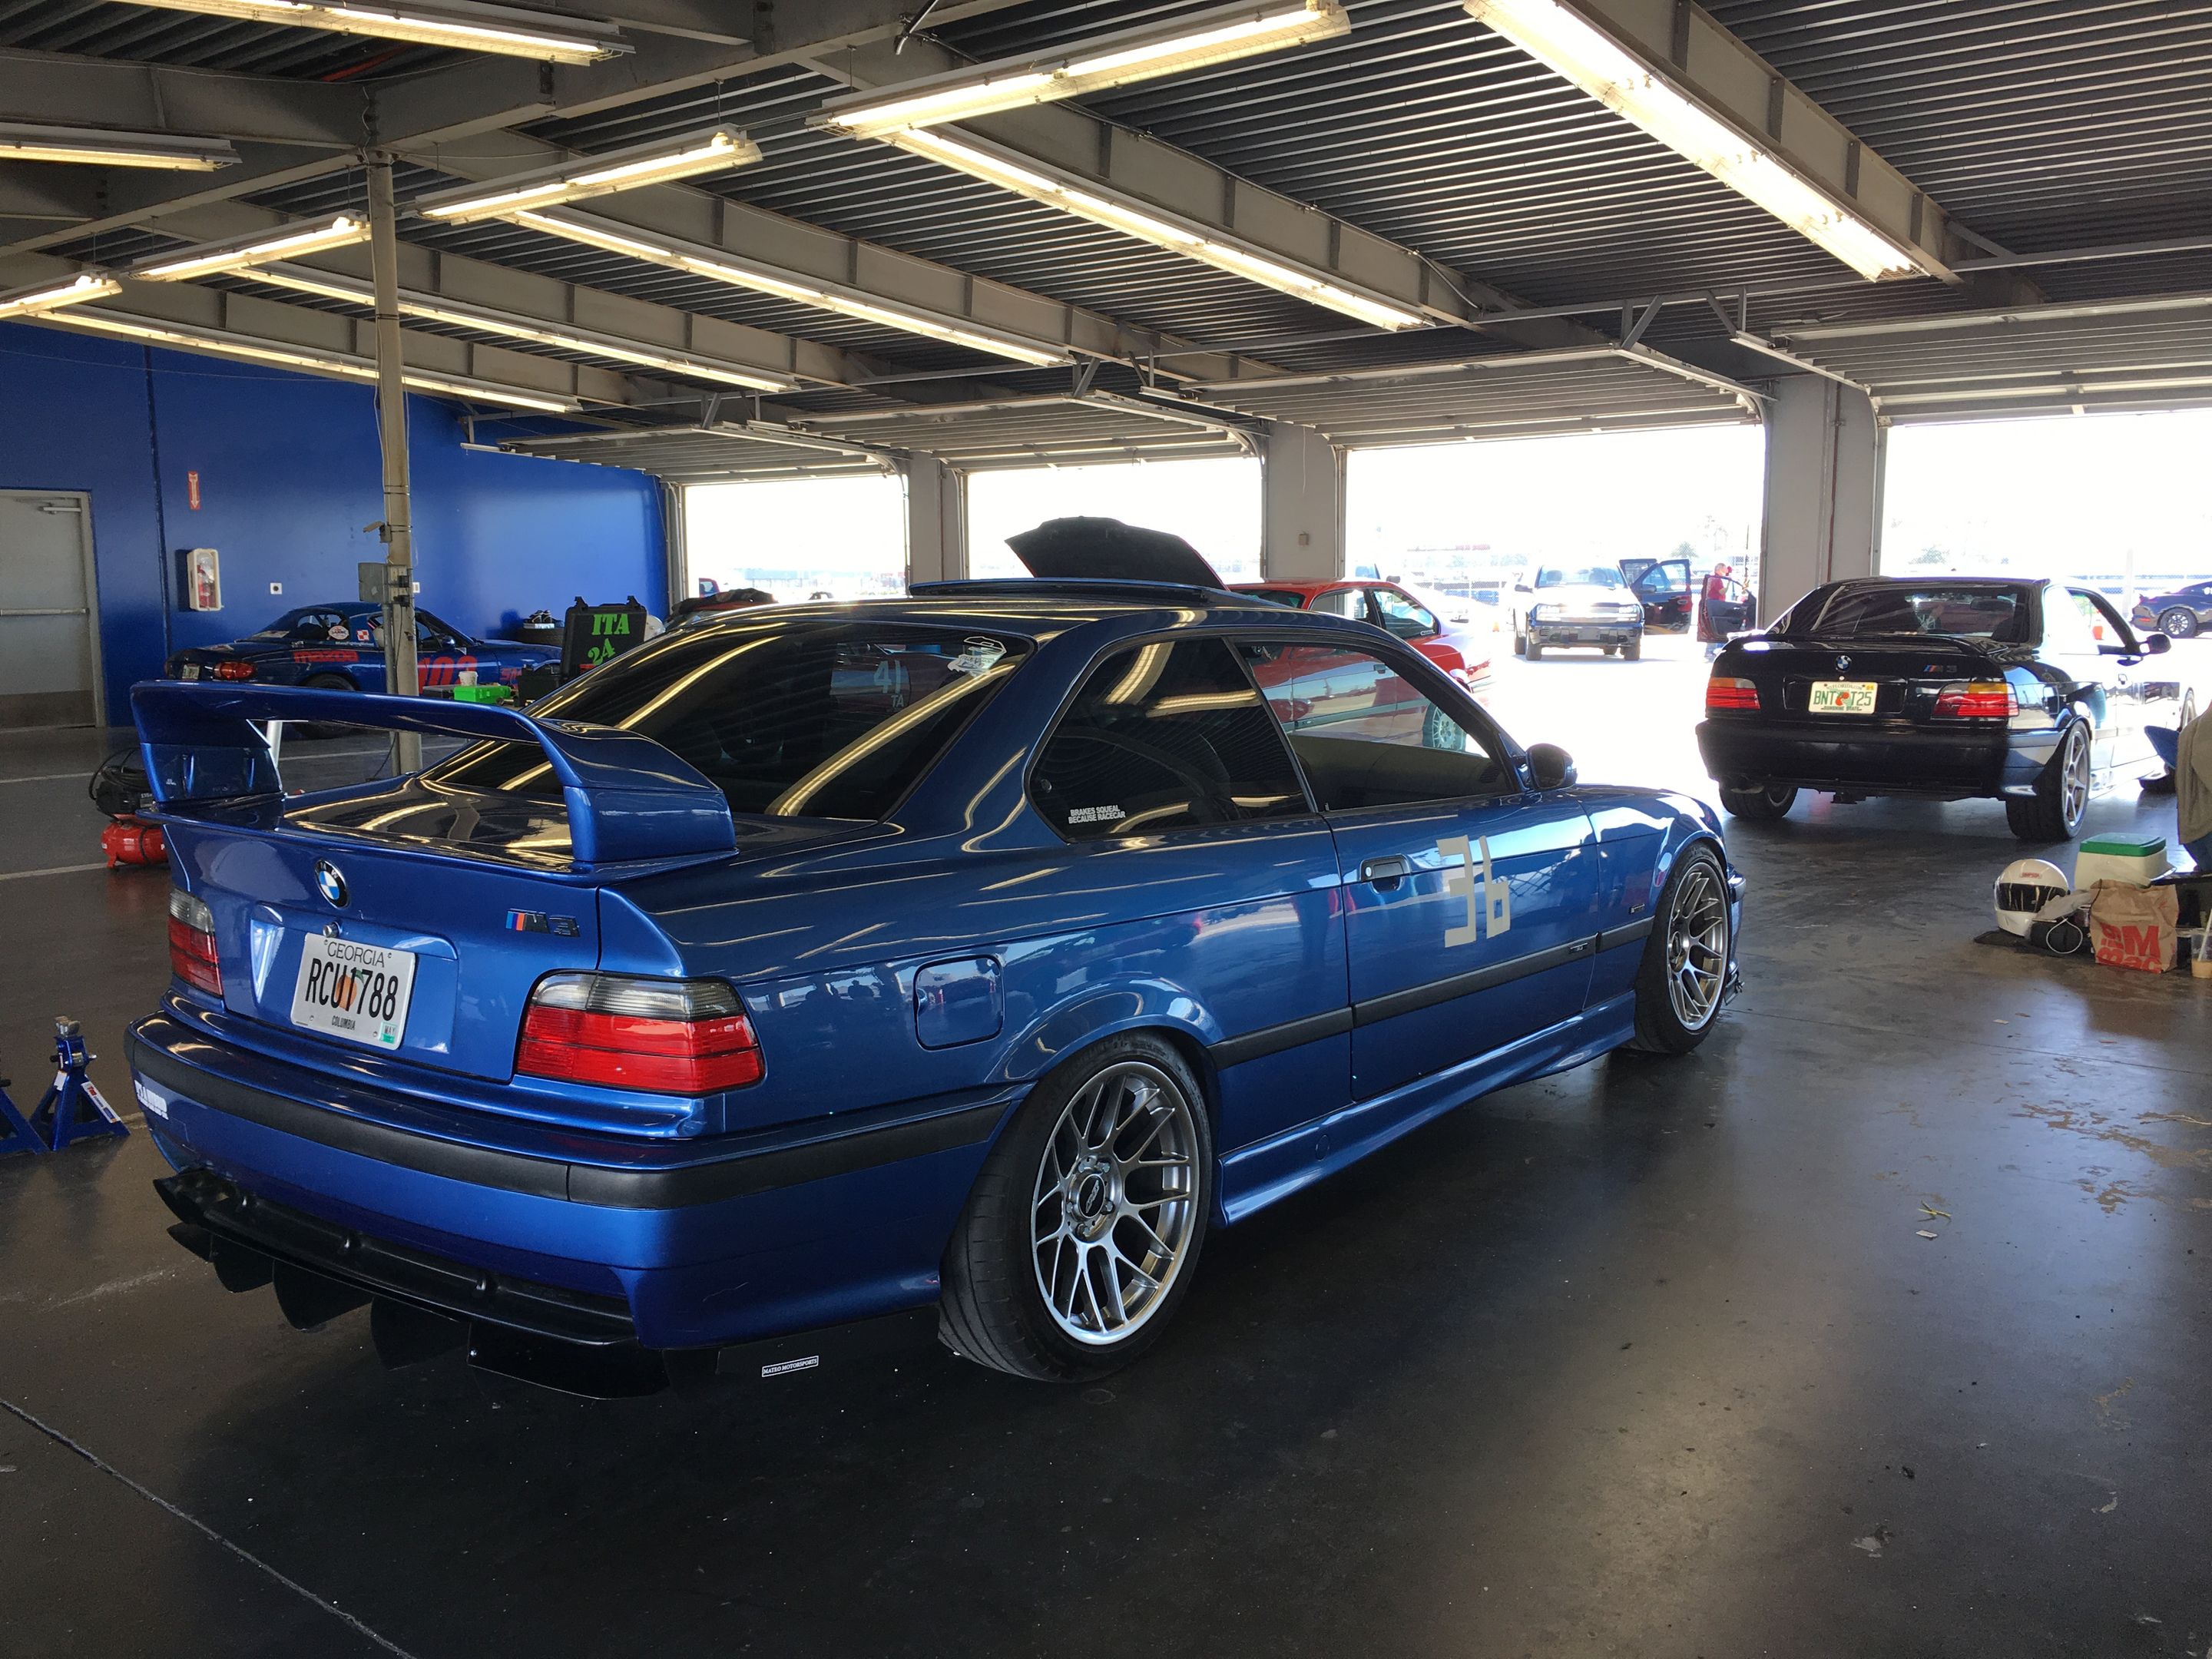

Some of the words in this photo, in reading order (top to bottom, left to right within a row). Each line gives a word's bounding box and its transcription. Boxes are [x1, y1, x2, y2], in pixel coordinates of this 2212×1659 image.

[591, 614, 630, 635] ITA
[874, 660, 902, 694] 41
[1813, 690, 1836, 705] BNT
[1068, 814, 1097, 824] BECAUSE
[1098, 811, 1126, 820] RACECAR
[1070, 807, 1095, 816] BRAKES
[1096, 805, 1121, 814] SQUEAL
[327, 942, 385, 968] GEORGIA
[305, 958, 399, 1021] RCU1788
[332, 1015, 356, 1031] COLUMBIA
[763, 1366, 781, 1374] MATEO
[782, 1358, 817, 1370] MOTORSPORTS
